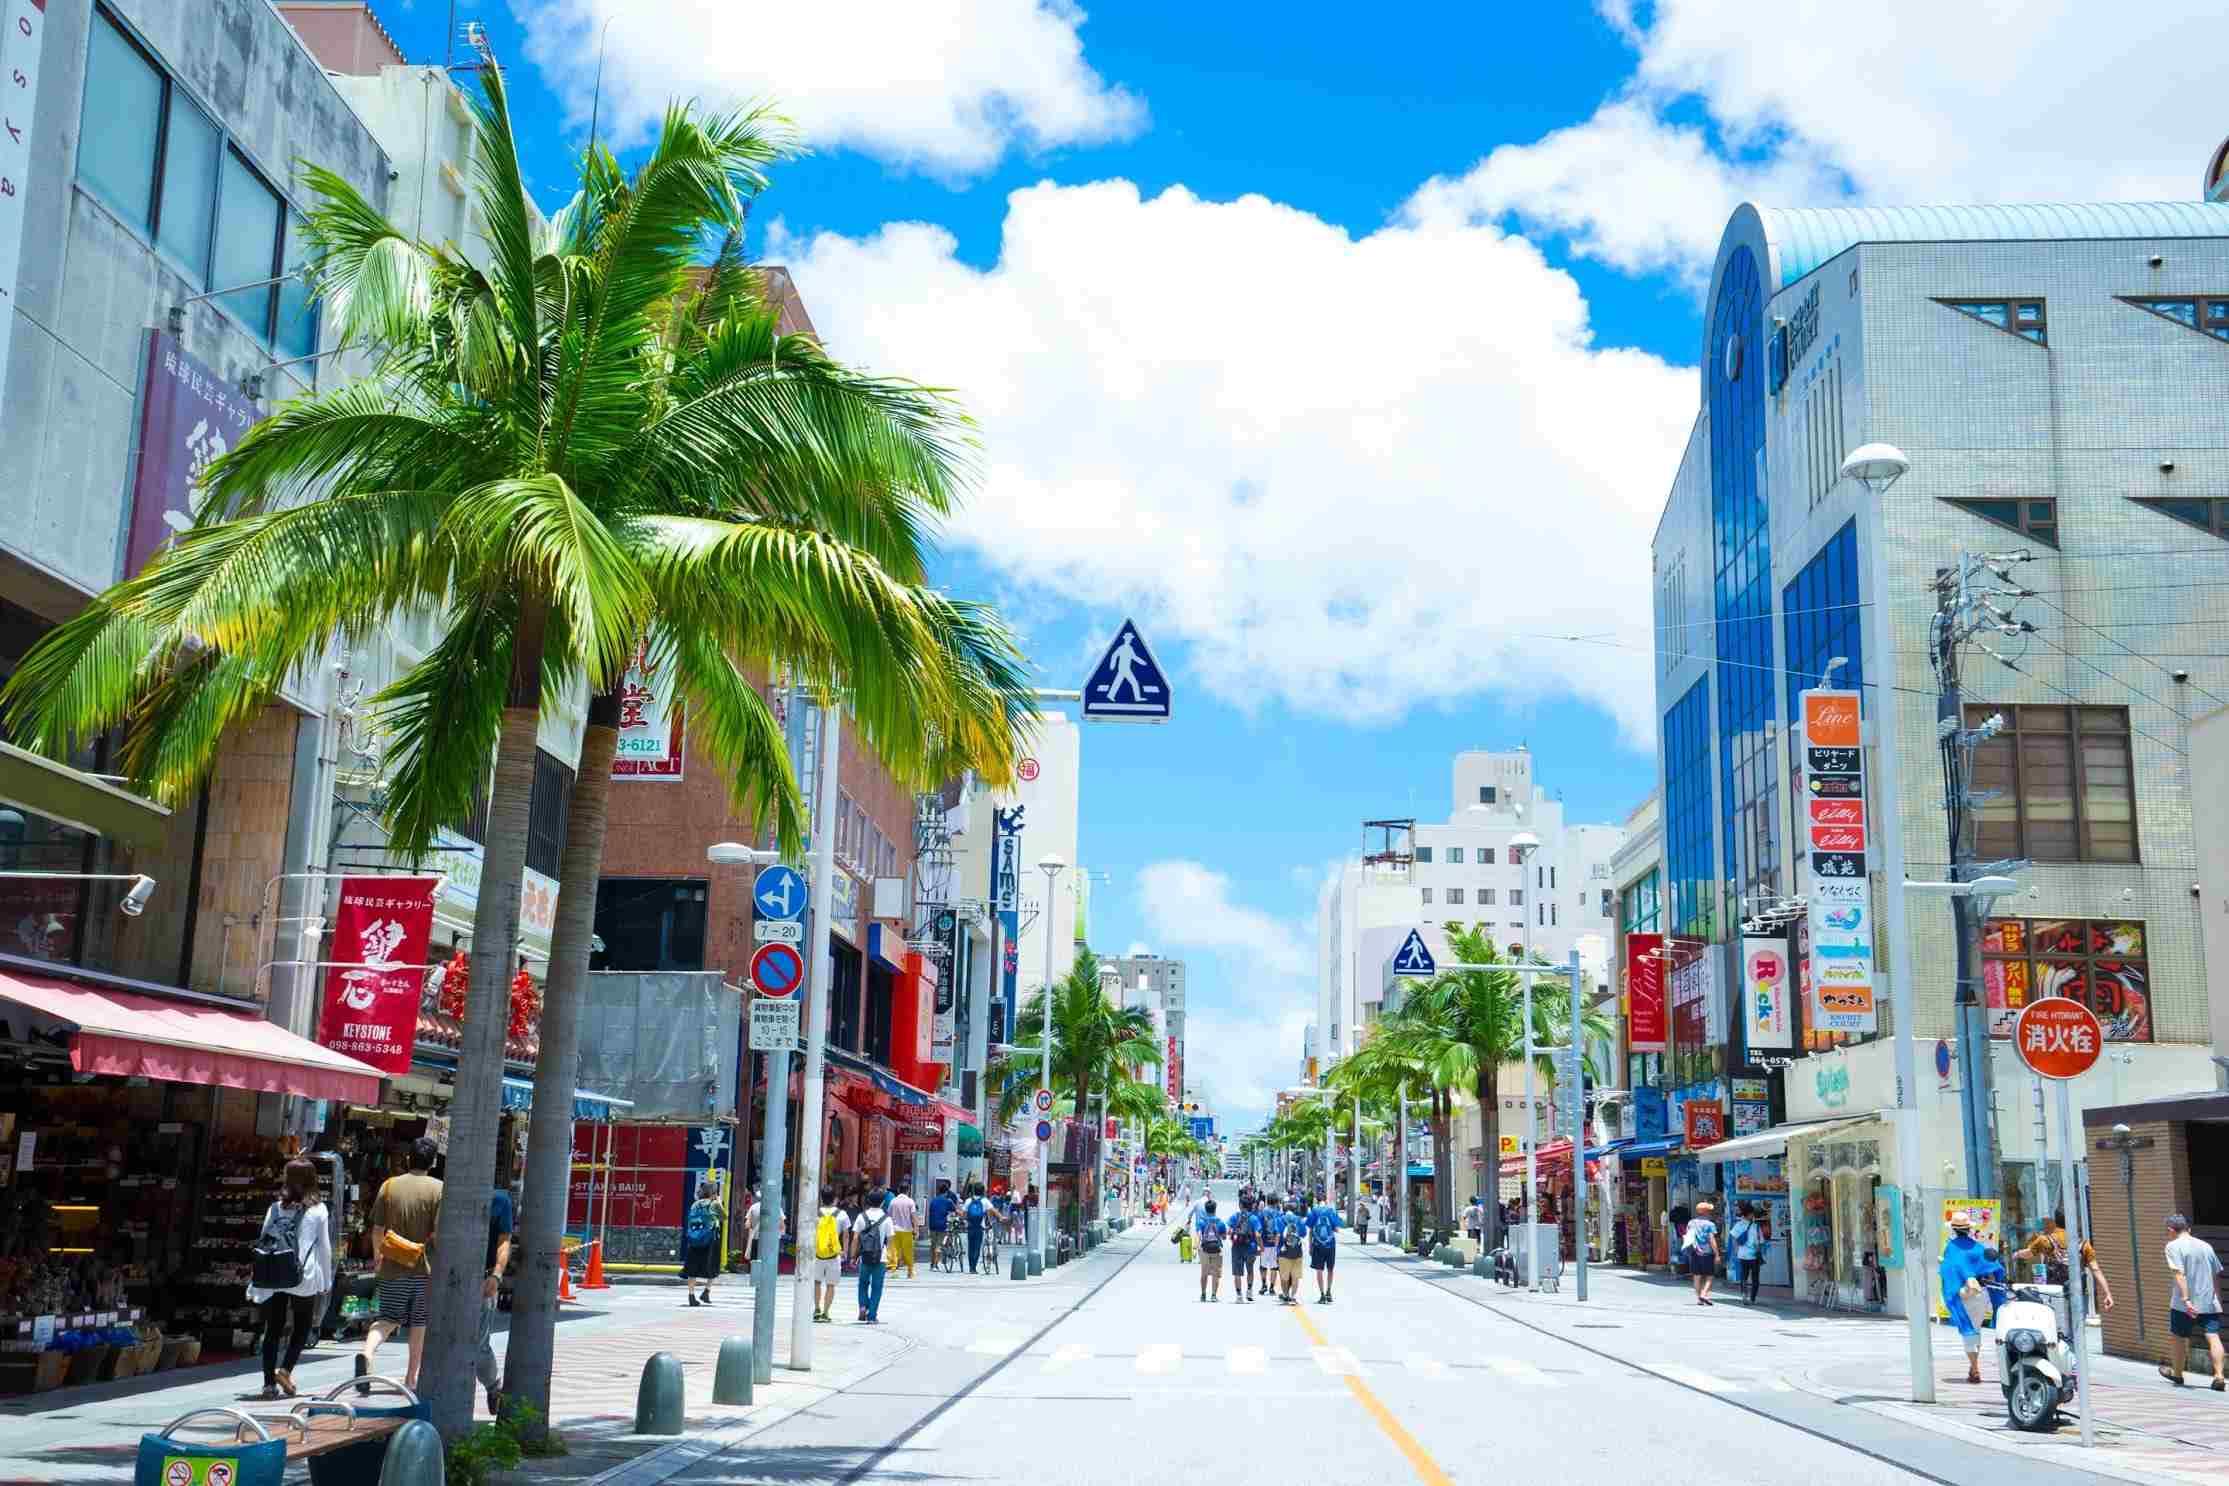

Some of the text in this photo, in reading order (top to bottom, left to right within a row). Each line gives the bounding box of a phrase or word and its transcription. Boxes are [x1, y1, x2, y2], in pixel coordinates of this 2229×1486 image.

[1815, 749, 1856, 759] ビリヤード
[1823, 762, 1848, 771] ダーツ
[2031, 1011, 2048, 1020] FIRE
[343, 1022, 393, 1042] KEYSTONE
[2025, 1023, 2095, 1054] 消火栓
